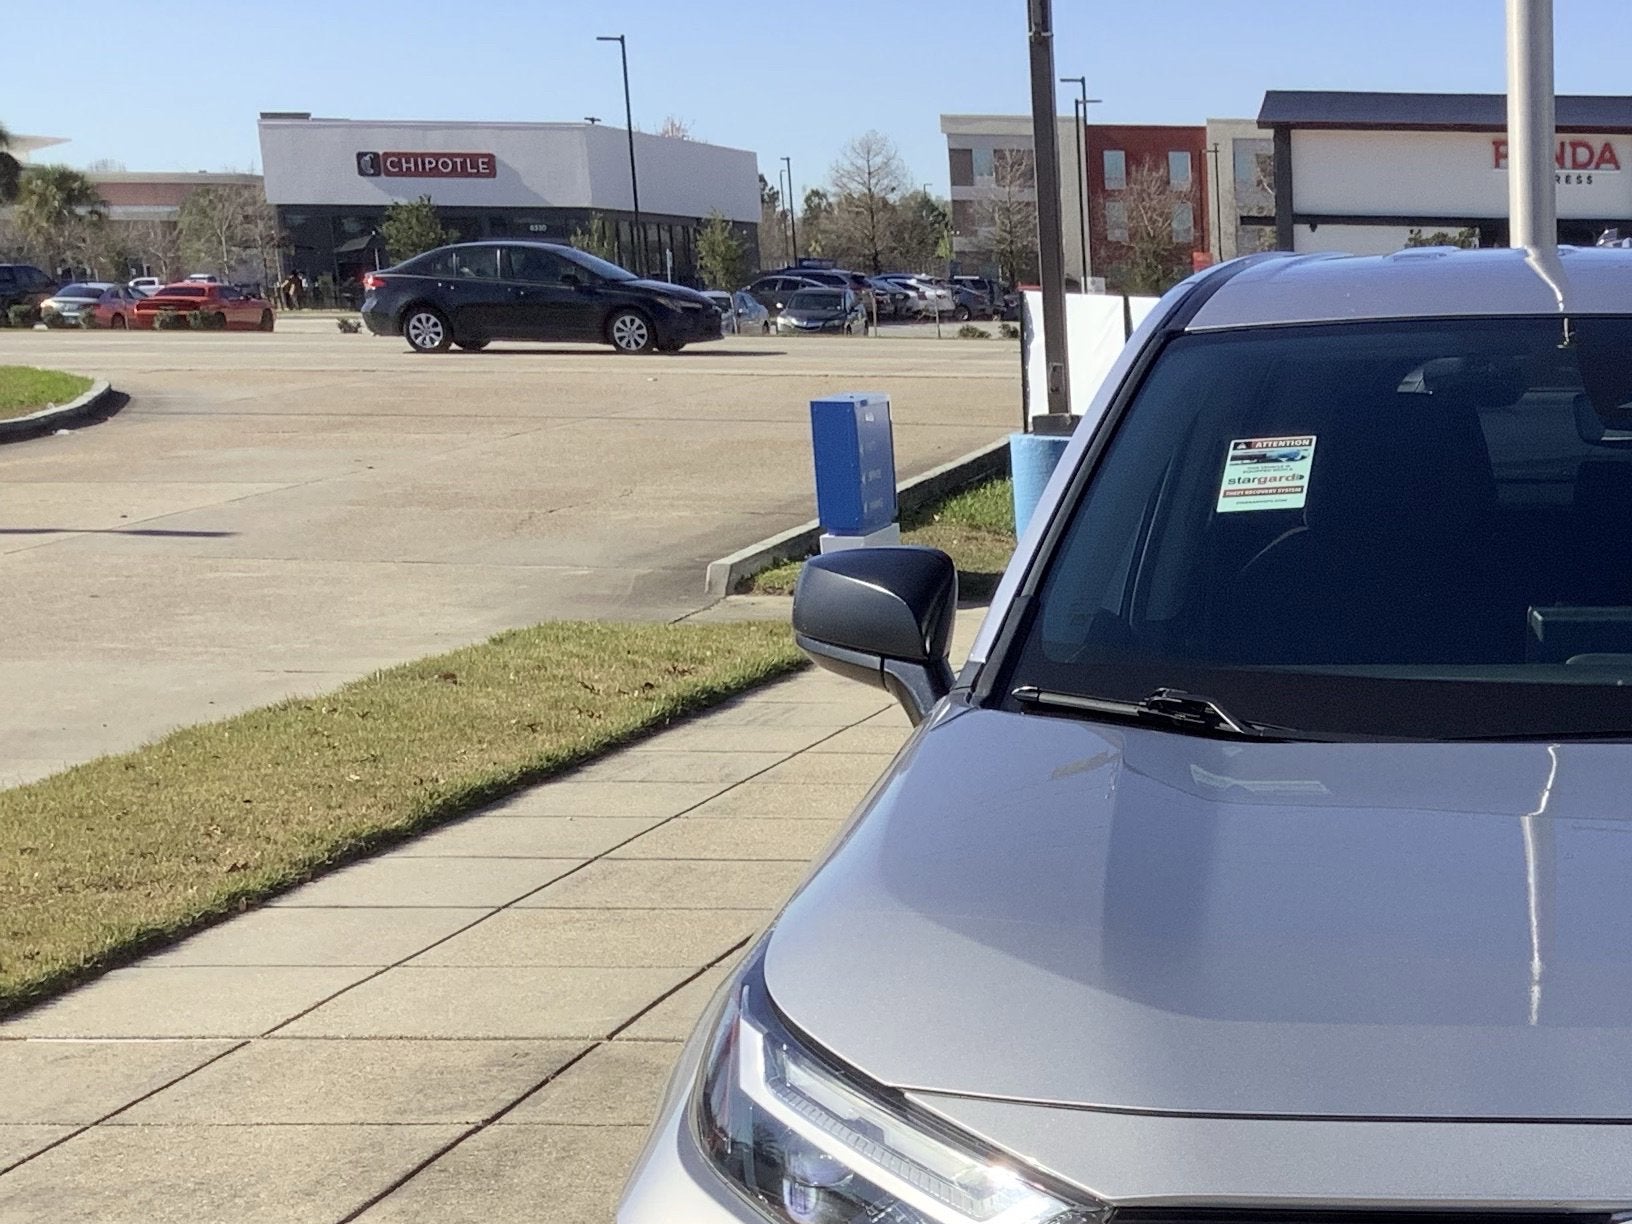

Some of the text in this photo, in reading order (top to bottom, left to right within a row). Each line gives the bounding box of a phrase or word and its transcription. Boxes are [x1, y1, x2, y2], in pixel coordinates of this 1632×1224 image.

[386, 157, 490, 173] CHIPOTLE
[1255, 439, 1310, 449] ATTENTION
[1227, 473, 1295, 485] stargard
